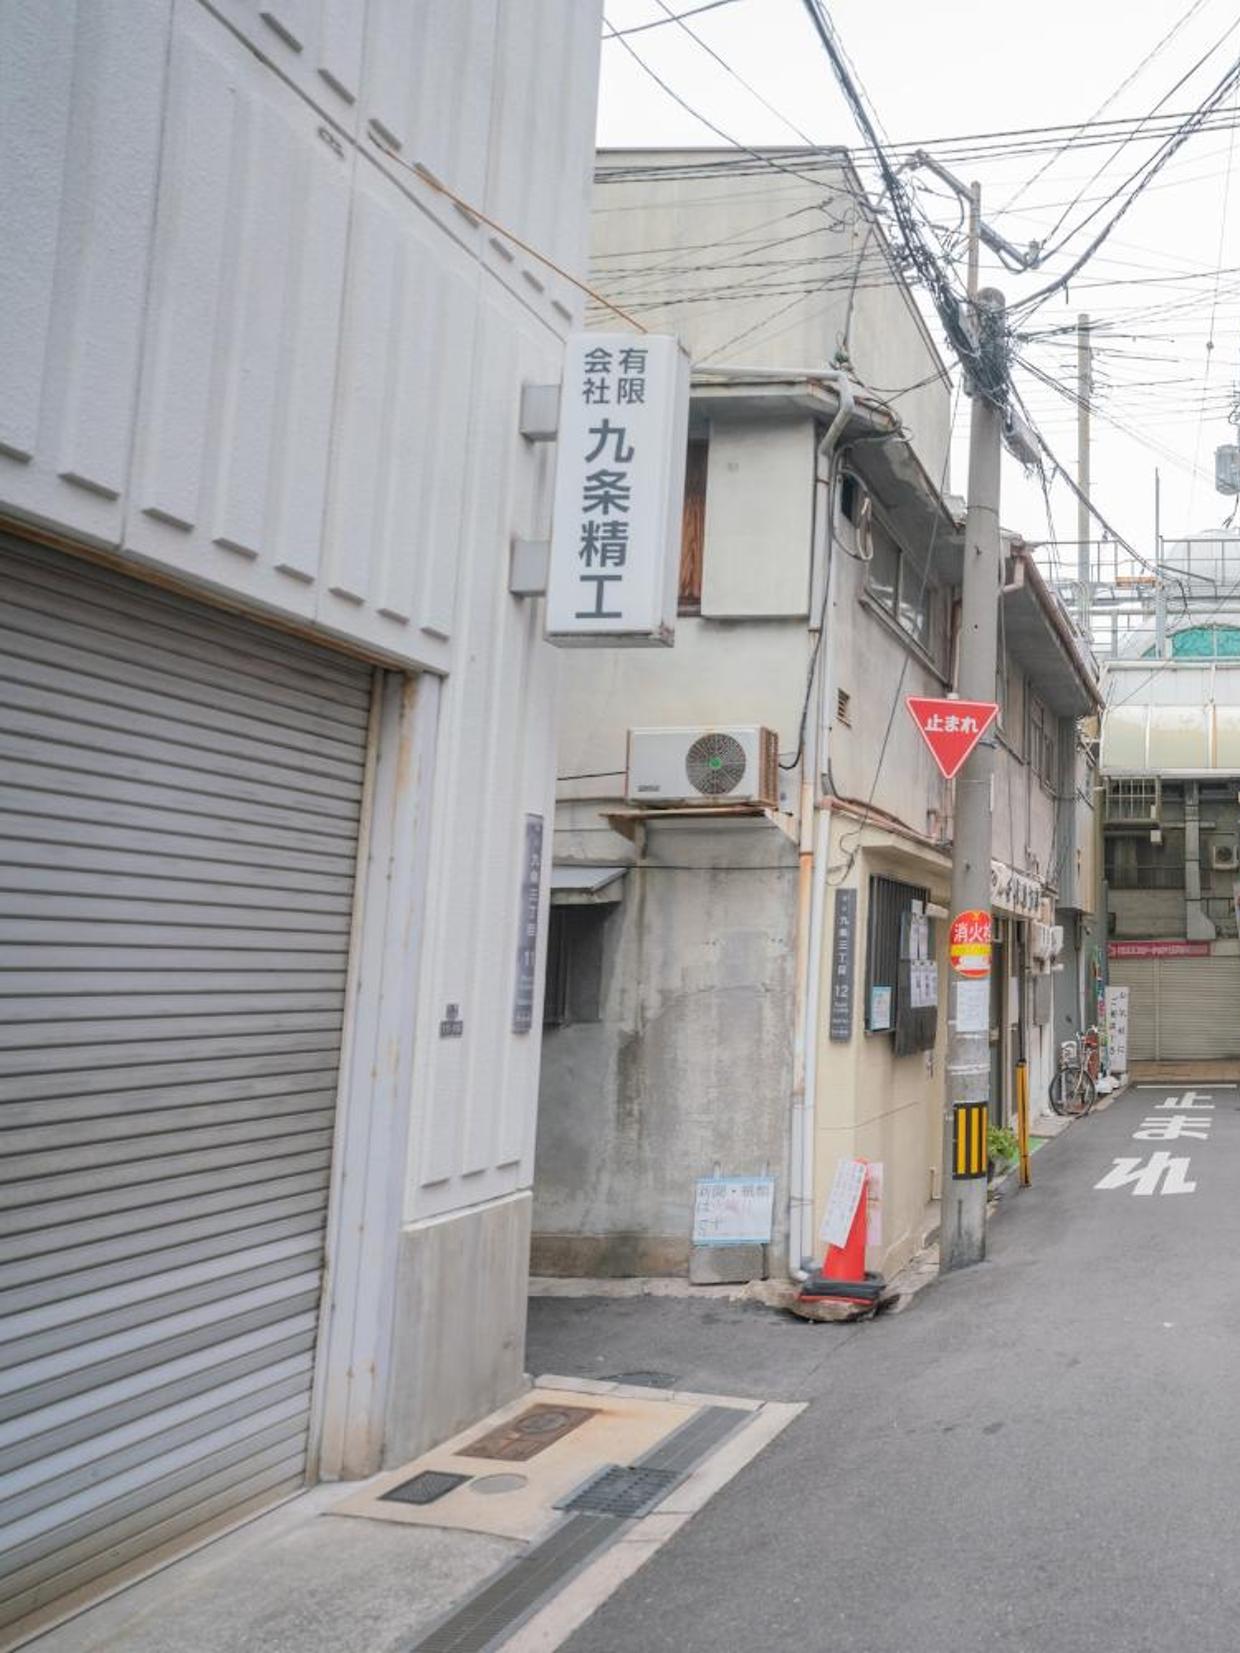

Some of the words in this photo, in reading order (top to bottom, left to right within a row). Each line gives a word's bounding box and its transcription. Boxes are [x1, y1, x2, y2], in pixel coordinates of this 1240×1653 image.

[581, 347, 613, 405] 会社
[616, 347, 649, 405] 有限
[575, 418, 634, 619] 九条精工
[924, 713, 979, 734] 止まれ
[1093, 1091, 1216, 1196] 止まれ
